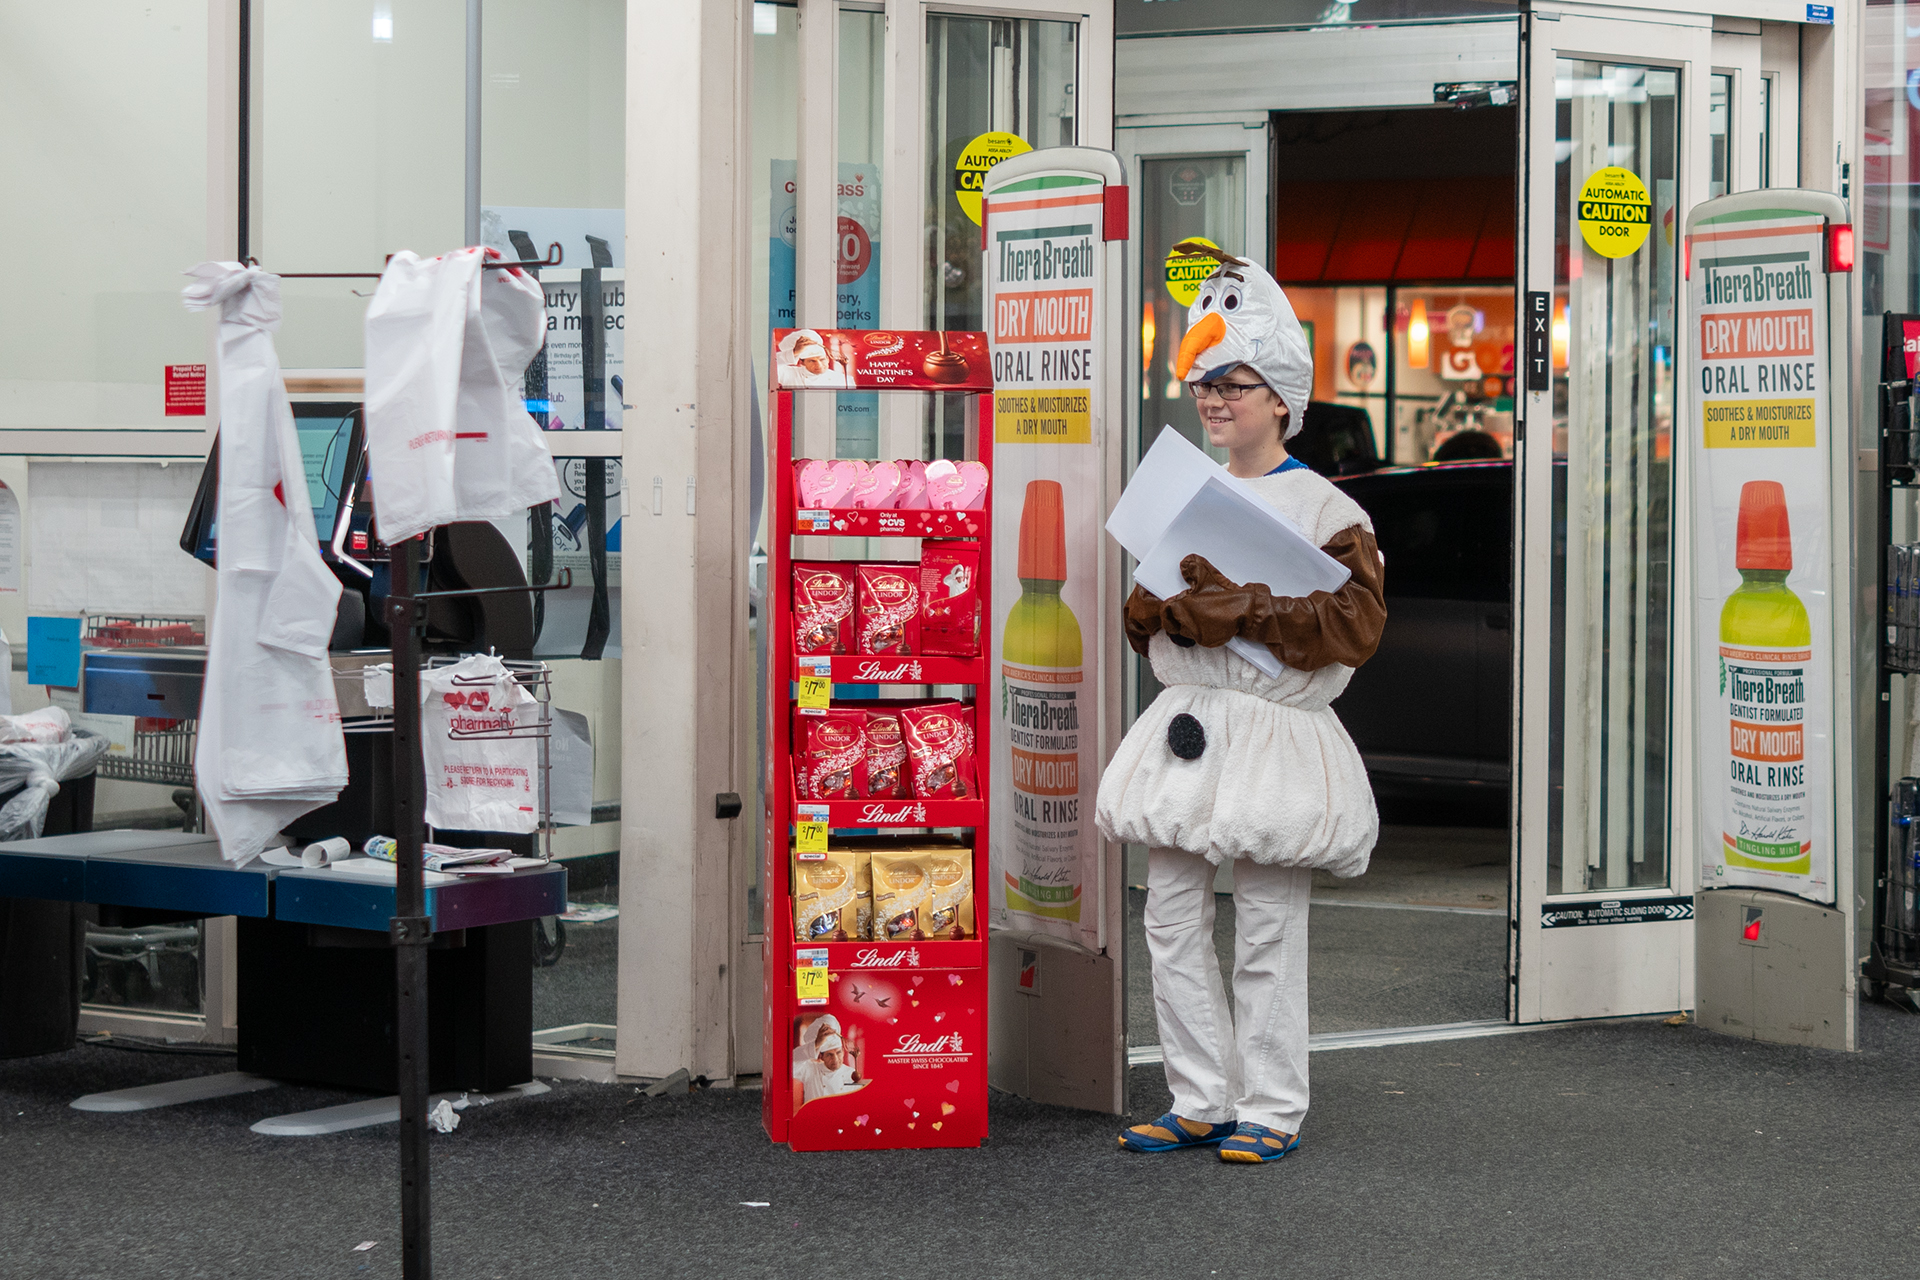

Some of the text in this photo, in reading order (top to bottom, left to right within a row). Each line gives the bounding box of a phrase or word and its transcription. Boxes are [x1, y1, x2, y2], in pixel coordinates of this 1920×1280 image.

[1586, 188, 1644, 201] AUTOMATIC
[1582, 202, 1648, 222] CAUTION
[1600, 225, 1630, 237] DOOR
[996, 224, 1093, 282] TheraBreath
[1699, 251, 1812, 305] TheraBreath
[837, 309, 872, 322] perks
[998, 296, 1090, 338] DRY MOUTH
[1534, 297, 1545, 373] EXIT
[1706, 315, 1810, 354] DRY MOUTH
[856, 368, 914, 376] VALENTINE'S
[994, 348, 1092, 382] ORAL RINSE
[876, 376, 896, 384] DAY
[1702, 362, 1816, 394] ORAL RINSE
[838, 404, 870, 412] CVS.com
[998, 396, 1088, 414] SOOTHES & MOISTURIZES
[1707, 405, 1812, 422] SOOTHES & MOISTURIZES
[1016, 419, 1068, 435] A DRY MOUTH
[1730, 426, 1790, 441] A DRY MOUTH
[574, 478, 584, 486] you
[887, 518, 906, 526] CVS
[1756, 652, 1780, 661] CLINICAL
[852, 660, 910, 681] Lindt
[1742, 668, 1773, 676] PROFESSIONAL
[1729, 668, 1805, 704] TheraBreath
[1010, 689, 1079, 730] TheraBreath
[1730, 702, 1804, 722] DENTIST FORMULATED
[824, 734, 851, 742] LINDOR
[922, 730, 950, 740] LINDOR
[1010, 728, 1078, 750] DENTIST FORMULATED
[1734, 726, 1801, 756] DRY MOUTH
[444, 765, 463, 774] PLEASE
[1014, 754, 1076, 790] DRY MOUTH
[1730, 760, 1804, 787] ORAL RINSE
[856, 804, 914, 824] Lindt
[1014, 792, 1078, 824] ORAL RINSE
[1738, 840, 1798, 856] TINGLING MINT
[1554, 906, 1665, 920] CAUTION: AUTOMATIC SLIDING DOOR
[850, 948, 908, 968] Lindt
[892, 1034, 949, 1054] Lindt
[928, 1056, 968, 1064] CHOCOLATIER
